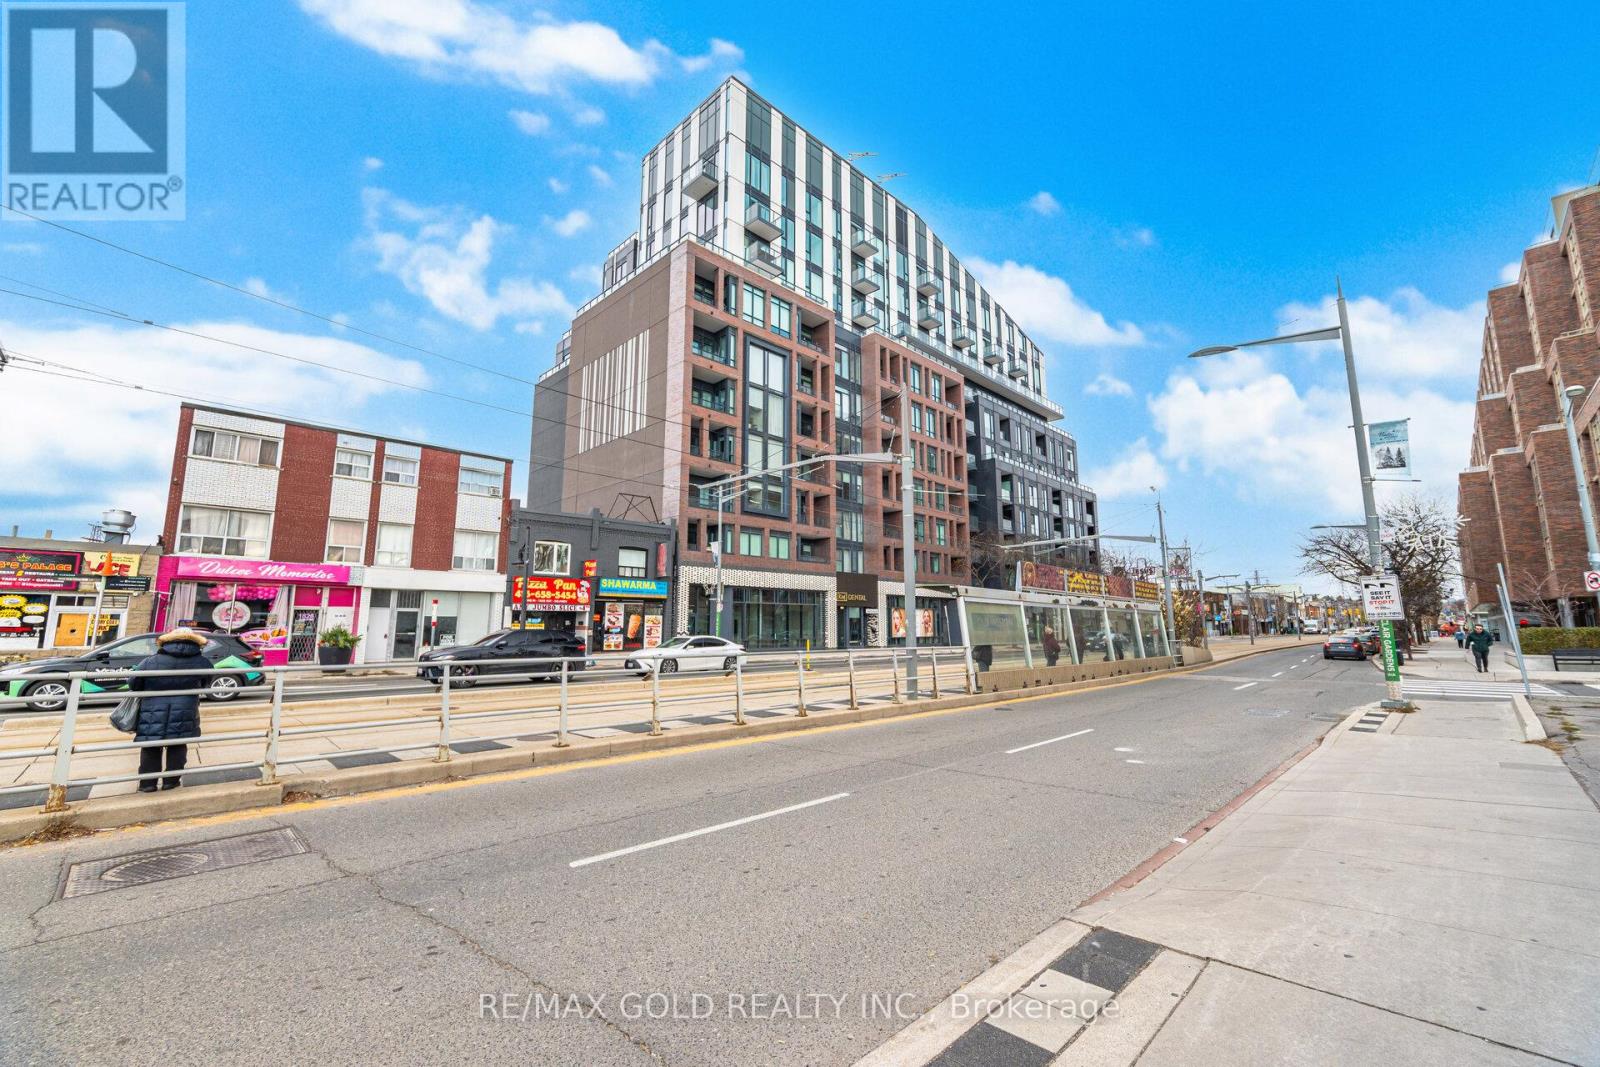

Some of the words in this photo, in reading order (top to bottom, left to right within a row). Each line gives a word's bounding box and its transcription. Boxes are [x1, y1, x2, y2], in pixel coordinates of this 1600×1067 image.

[23, 562, 72, 571] PALACE
[198, 561, 252, 576] Dulces
[258, 564, 336, 580] Momentos
[554, 579, 577, 590] Pan
[601, 579, 656, 590] SHAWARMA
[515, 590, 577, 599] 4-658-5454
[1384, 639, 1396, 672] GARDENS
